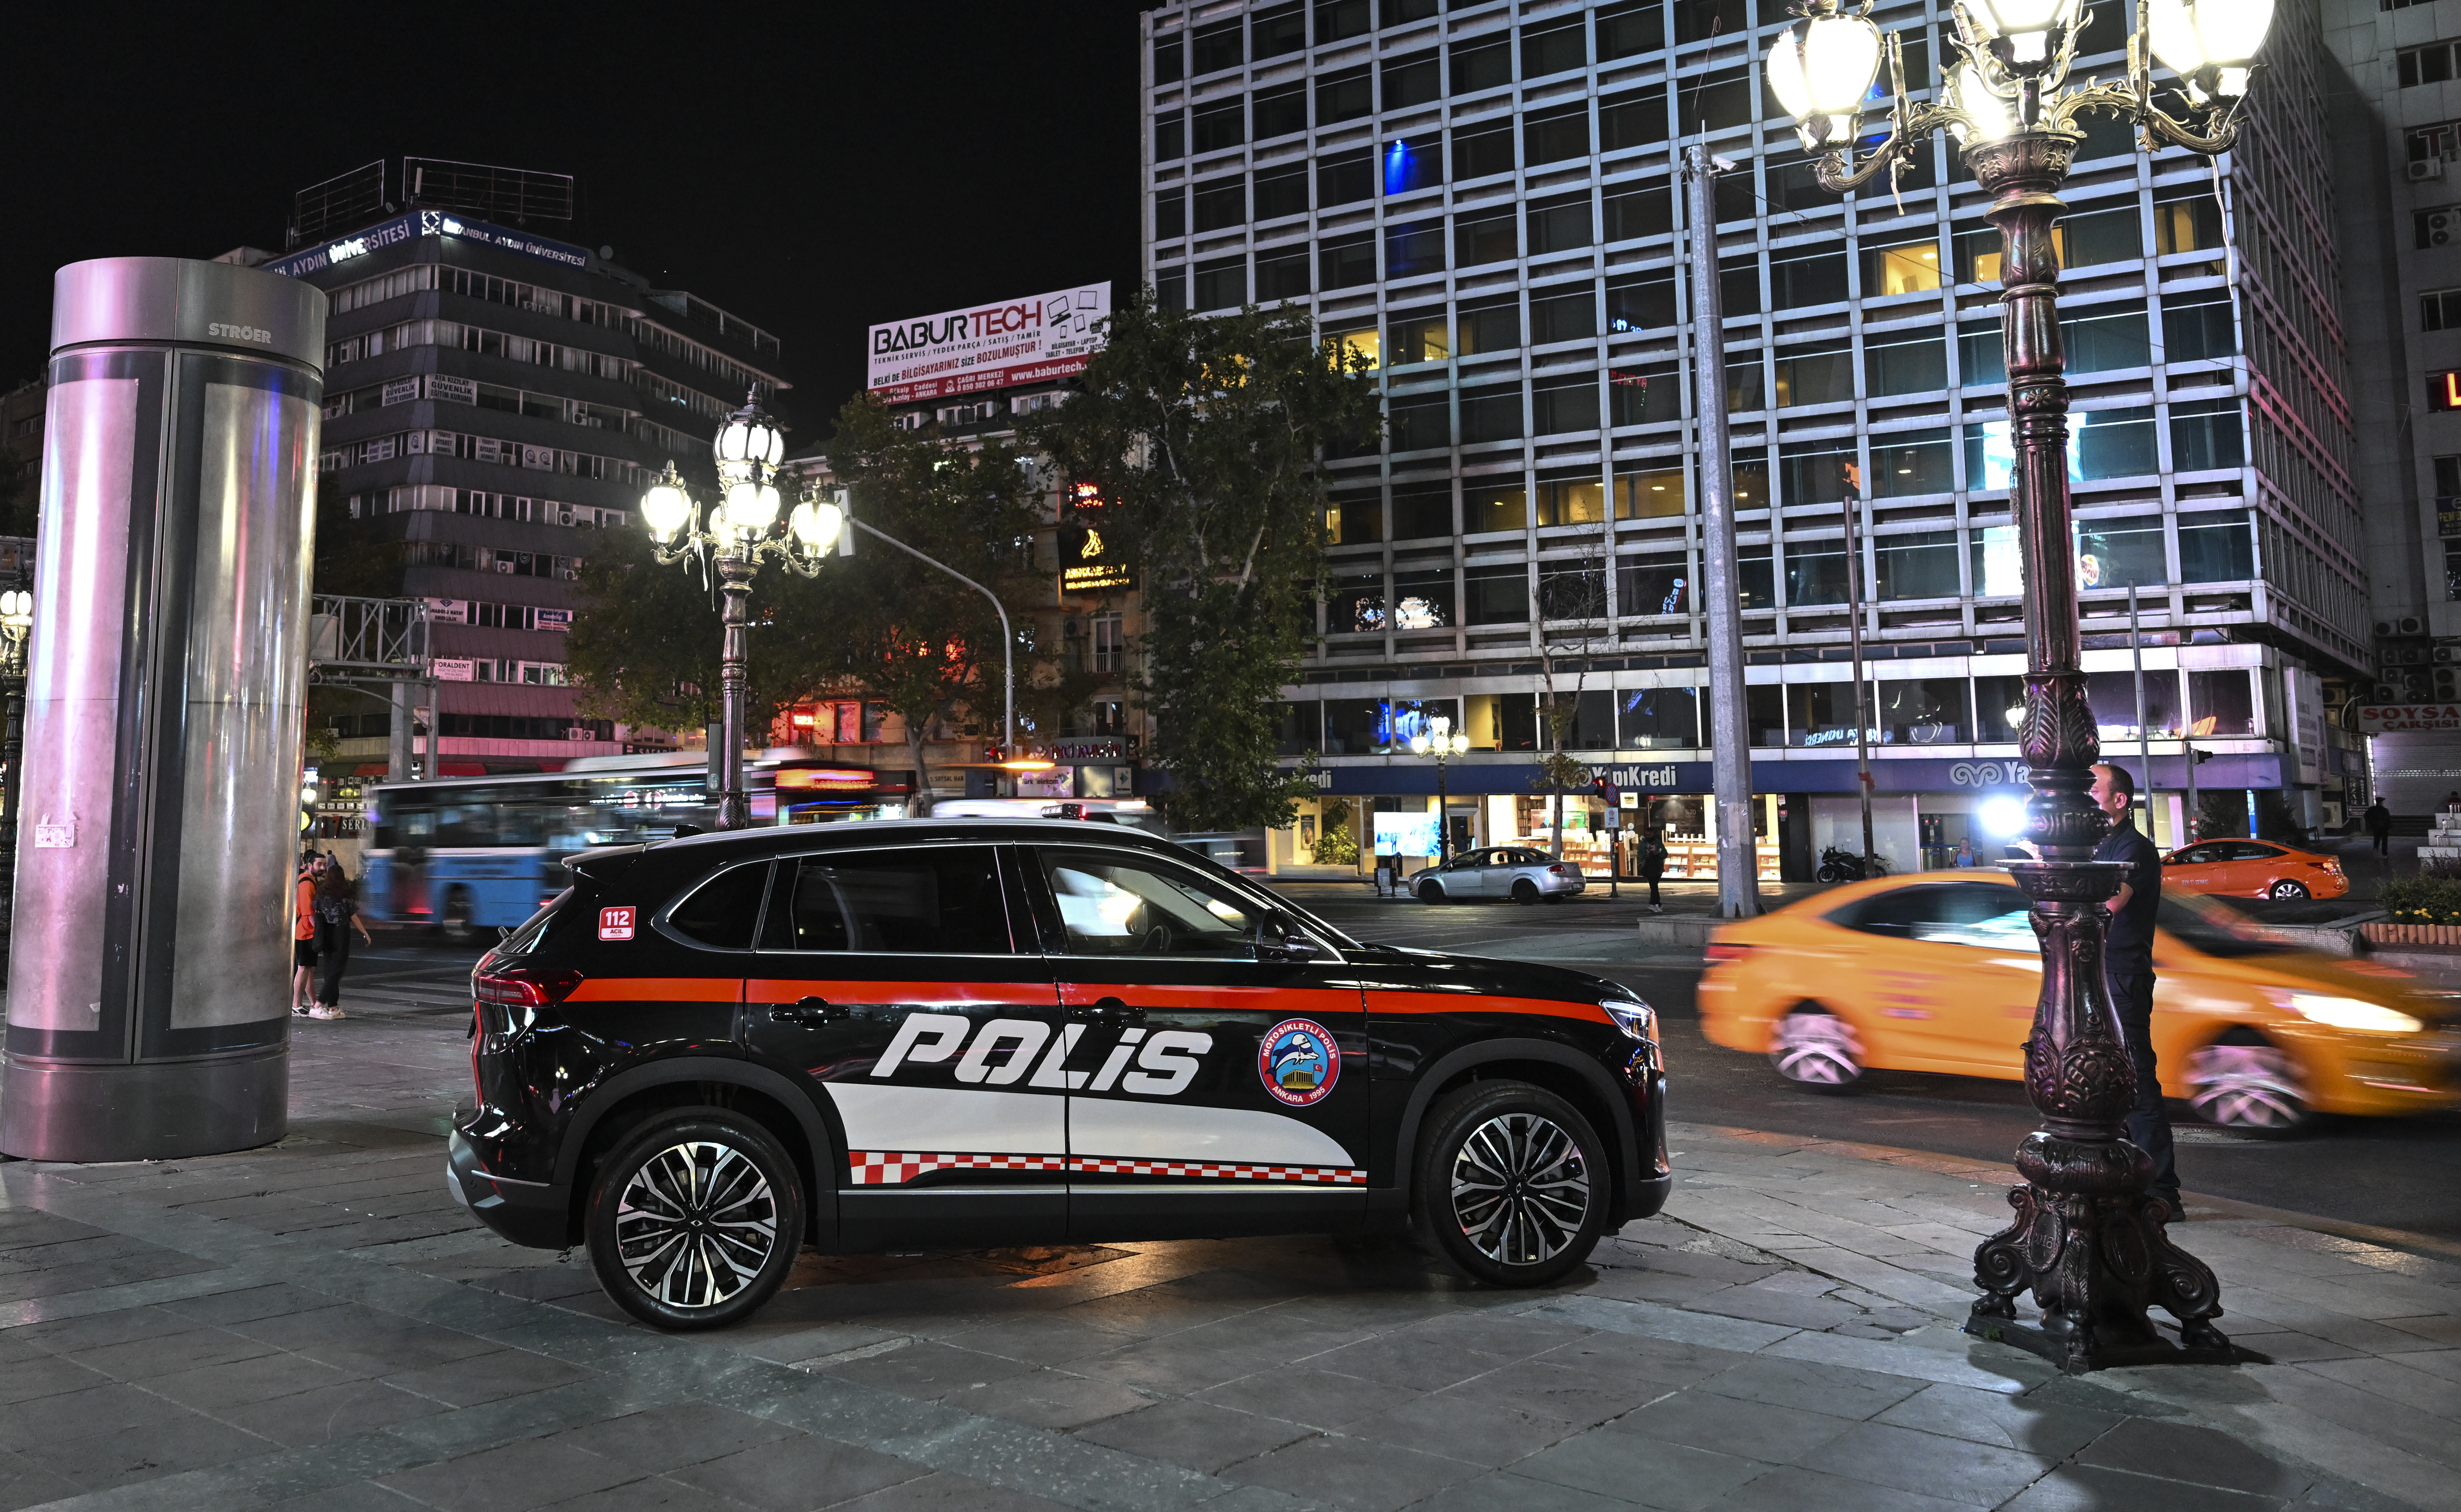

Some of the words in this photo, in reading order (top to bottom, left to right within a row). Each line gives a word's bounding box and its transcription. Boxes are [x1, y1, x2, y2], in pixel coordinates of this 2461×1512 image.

[495, 236, 524, 251] AYDIN
[526, 242, 586, 267] ÜNİVERSİTESİ
[293, 252, 328, 276] AYDIN
[209, 323, 271, 344] STRÖER
[1081, 337, 1098, 345] LAPTOP
[875, 355, 899, 365] TEKNİK
[901, 349, 925, 360] SERVİS
[933, 345, 955, 355] YEDEK
[958, 341, 980, 350] PARÇA
[988, 336, 1009, 345] SATIŞ
[1017, 330, 1040, 341] TAMİR
[1046, 350, 1060, 358] TABLET
[1066, 346, 1084, 355] TELEFON
[873, 373, 890, 386] BELKİ
[892, 373, 900, 382] DE
[902, 358, 959, 380] BİLGİSAYARINIZ
[961, 356, 975, 367] SİZE
[977, 341, 1036, 364] BOZULMUŞTUR
[1011, 361, 1087, 381] www.baburtech.
[978, 369, 1004, 381] MERKEZİ
[386, 383, 415, 396] GÜVENLİK
[431, 381, 472, 395] GÜVENLİK
[914, 381, 937, 391] Caddesi
[915, 389, 937, 398] ANKARA
[450, 393, 472, 403] KURUMU
[606, 910, 629, 926] 112
[1263, 1023, 1319, 1057] MOTOSİKLETLİ
[1319, 1032, 1336, 1059] POLİS
[1272, 1086, 1303, 1102] ANKARA
[1309, 1086, 1325, 1100] 1995
